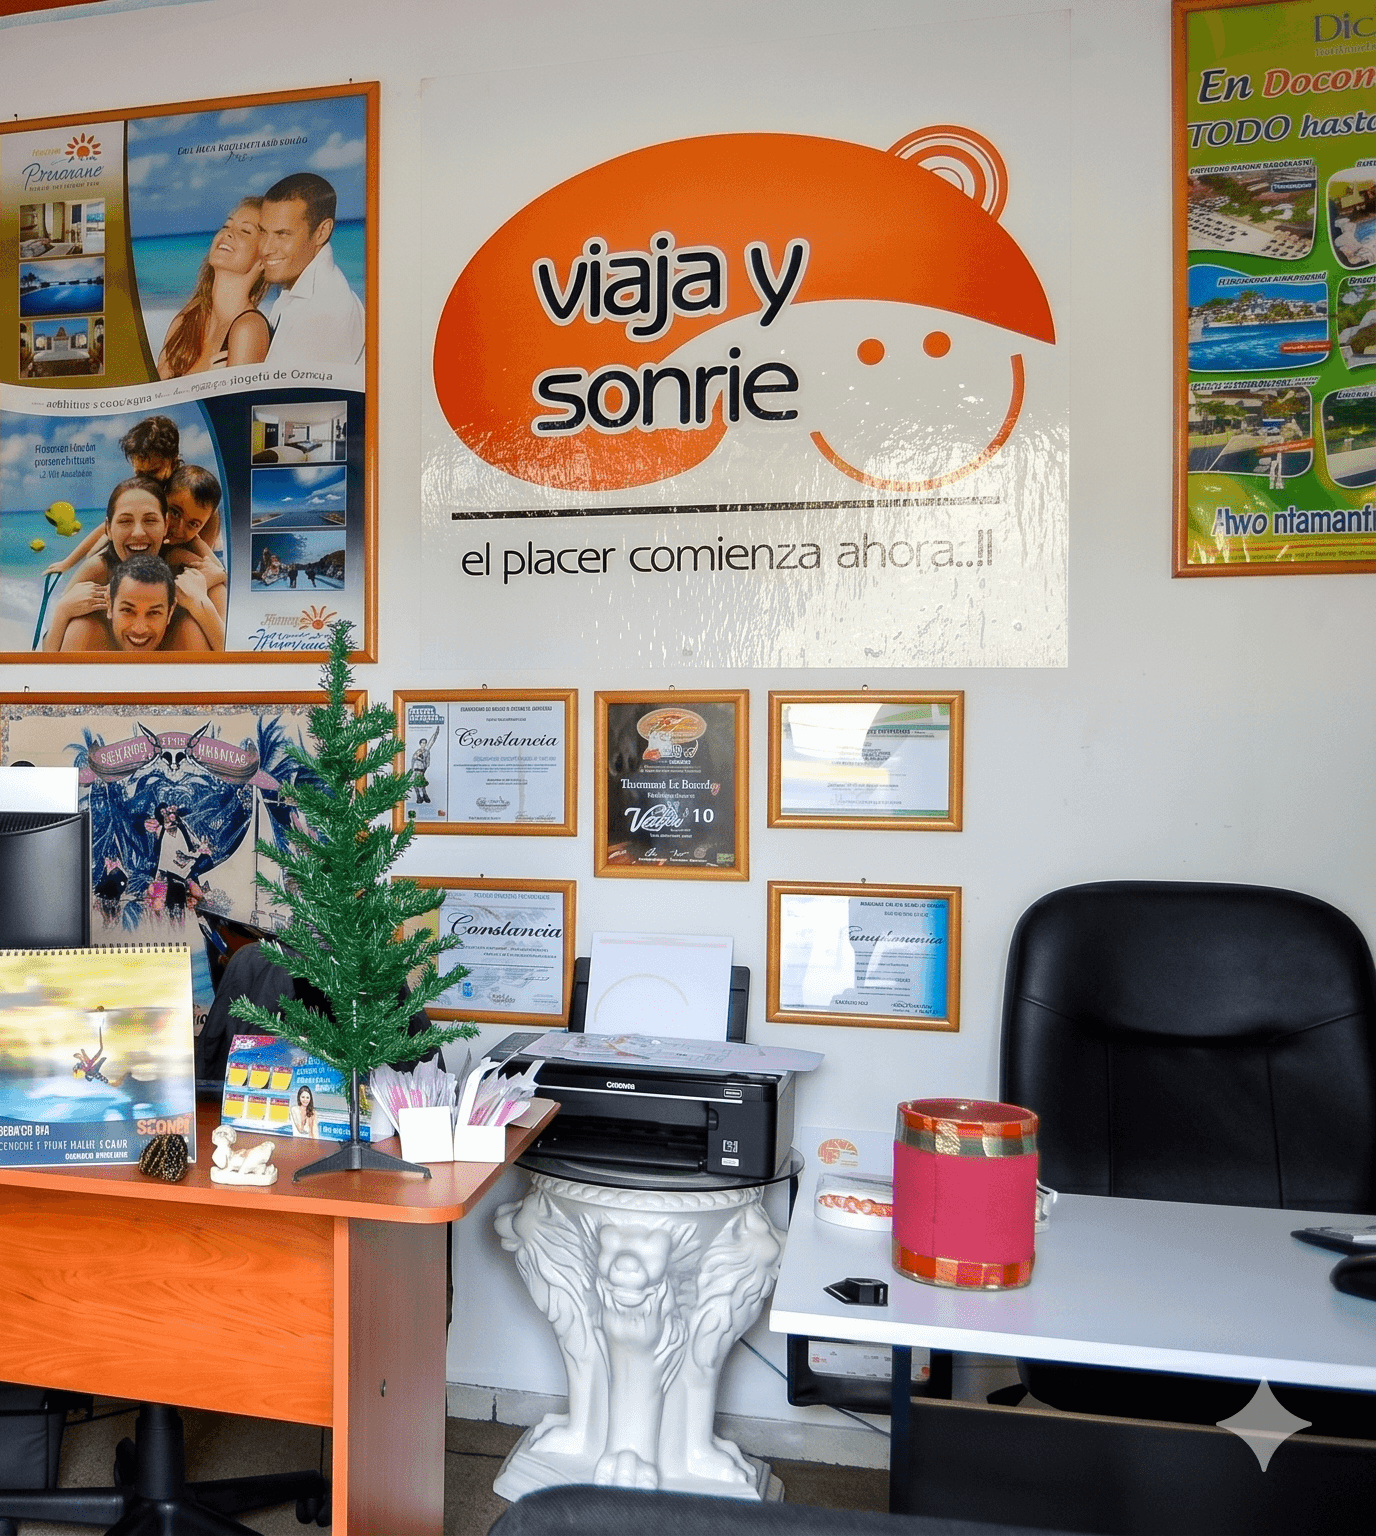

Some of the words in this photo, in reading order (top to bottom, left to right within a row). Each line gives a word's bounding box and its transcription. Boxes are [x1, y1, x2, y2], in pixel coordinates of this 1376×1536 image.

[1197, 67, 1254, 104] En
[1187, 114, 1292, 149] TODO
[537, 236, 721, 337] viaja
[750, 243, 805, 328] y
[272, 369, 288, 380] de
[536, 346, 800, 432] sonrie
[461, 541, 491, 577] el
[503, 540, 617, 585] placer
[628, 535, 822, 576] comienza
[692, 808, 715, 823] 10
[446, 911, 563, 939] Constancia
